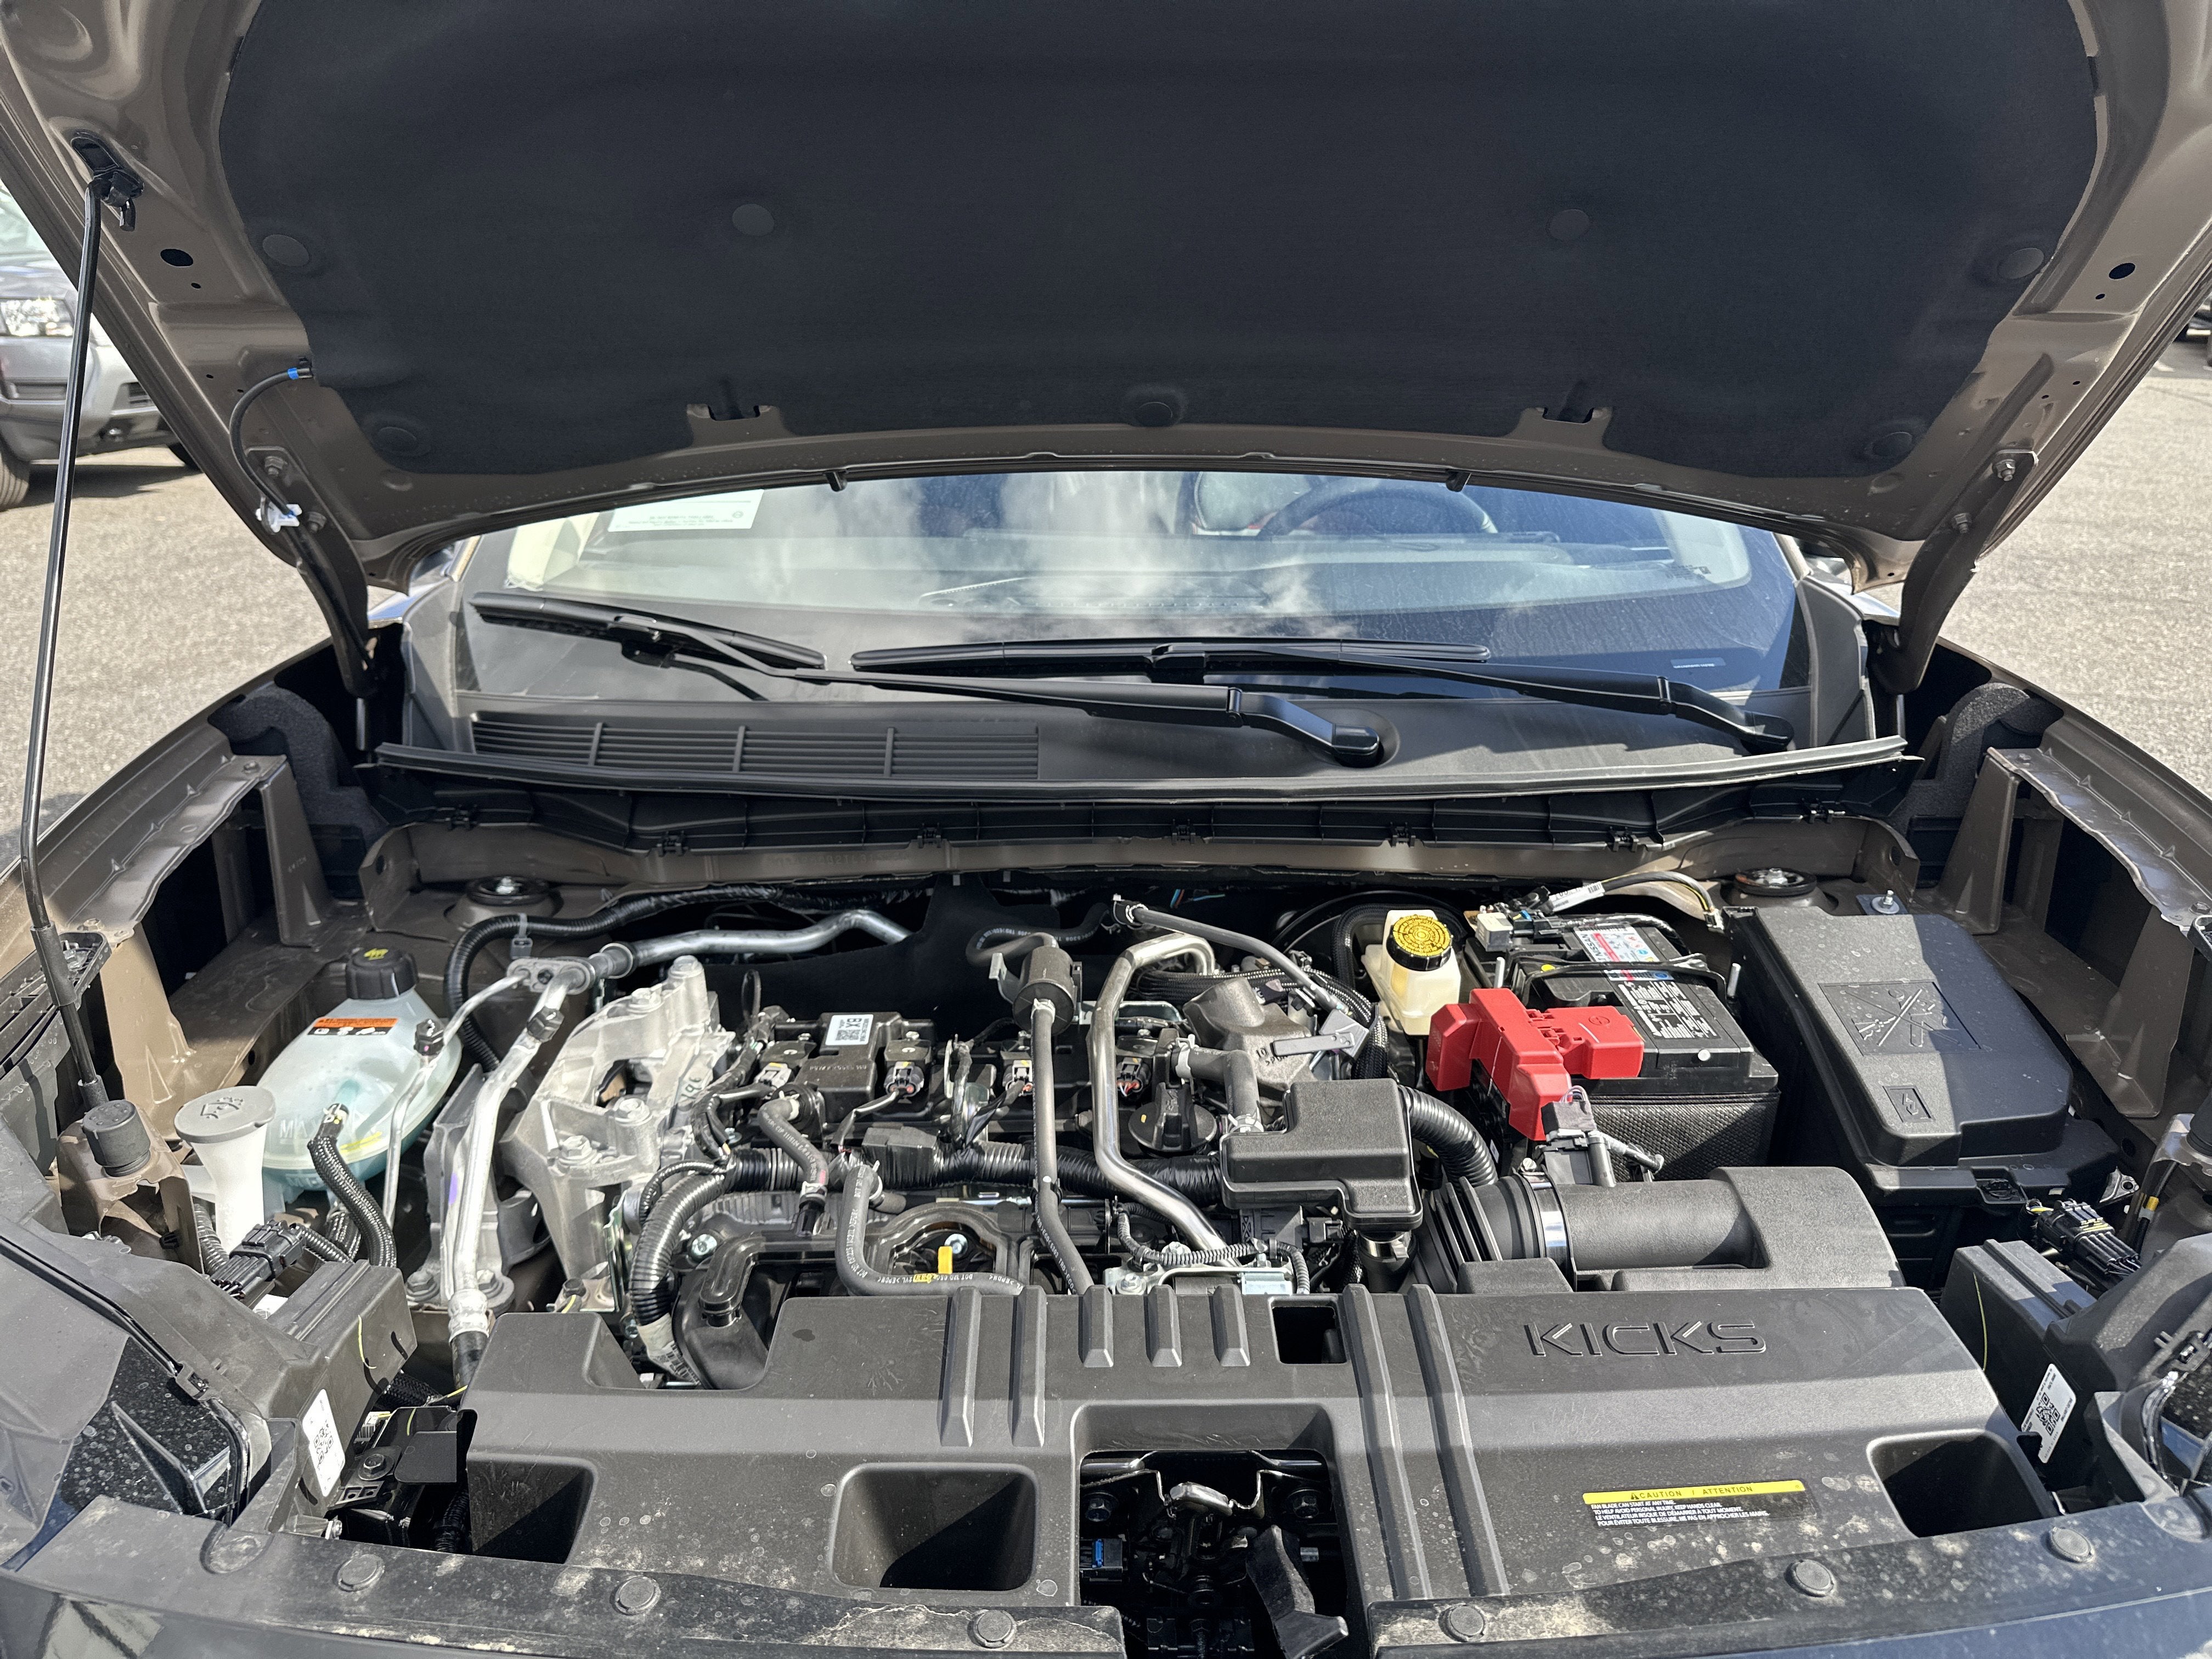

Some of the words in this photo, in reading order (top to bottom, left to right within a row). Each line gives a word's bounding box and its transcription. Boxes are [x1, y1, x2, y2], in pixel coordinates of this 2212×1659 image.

[847, 1018, 862, 1028] BX
[1523, 1321, 1766, 1357] KICKS
[1639, 1491, 1682, 1499] CAUTION
[1703, 1486, 1753, 1494] ATTENTION
[1603, 1512, 1638, 1520] VENTILATEUR
